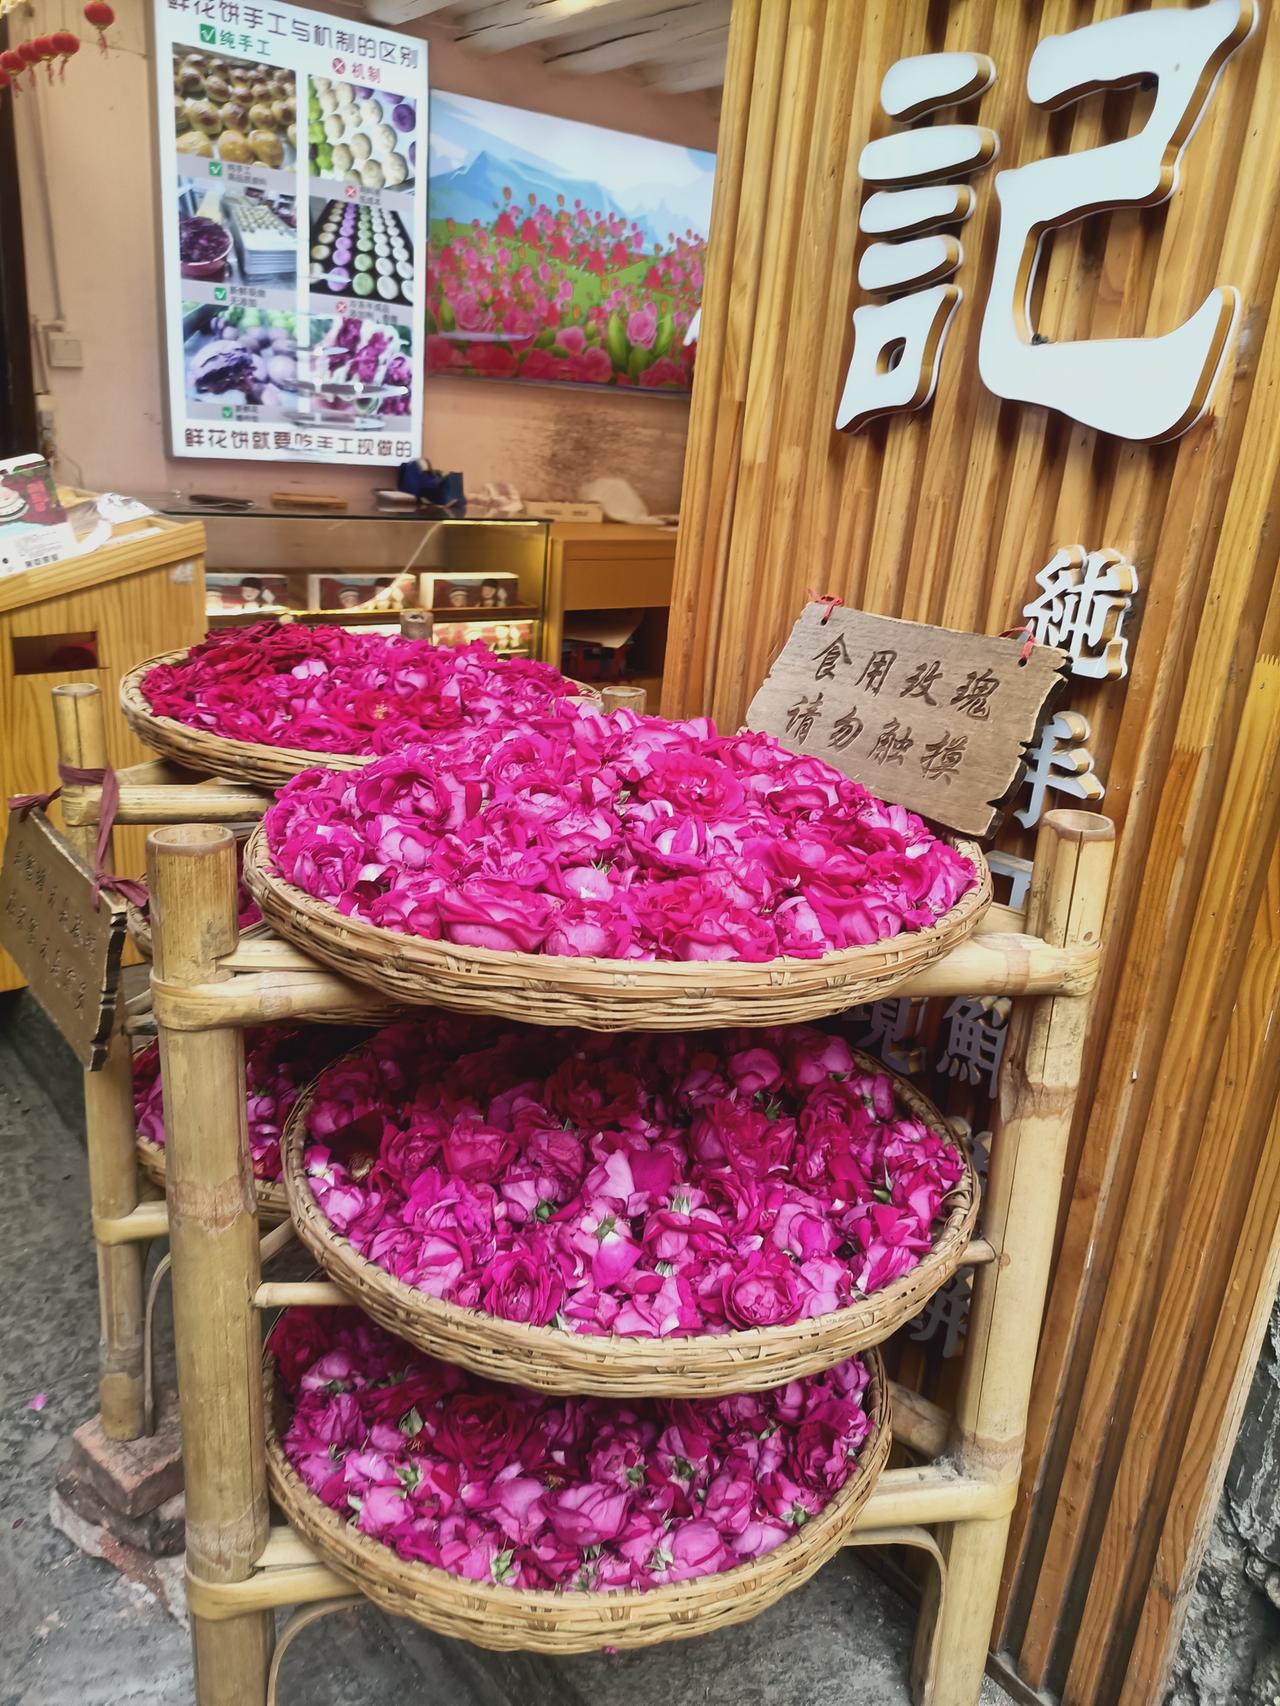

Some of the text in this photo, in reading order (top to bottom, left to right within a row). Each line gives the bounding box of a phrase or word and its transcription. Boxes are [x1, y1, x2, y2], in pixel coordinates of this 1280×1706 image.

[219, 29, 272, 57] 纯手工
[351, 62, 382, 84] 机制
[835, 0, 1259, 444] 記
[184, 427, 413, 458] 鲜花饼就要吃手工现做的
[812, 632, 1001, 722] 食用玫瑰
[785, 691, 969, 786] 请勿触摸
